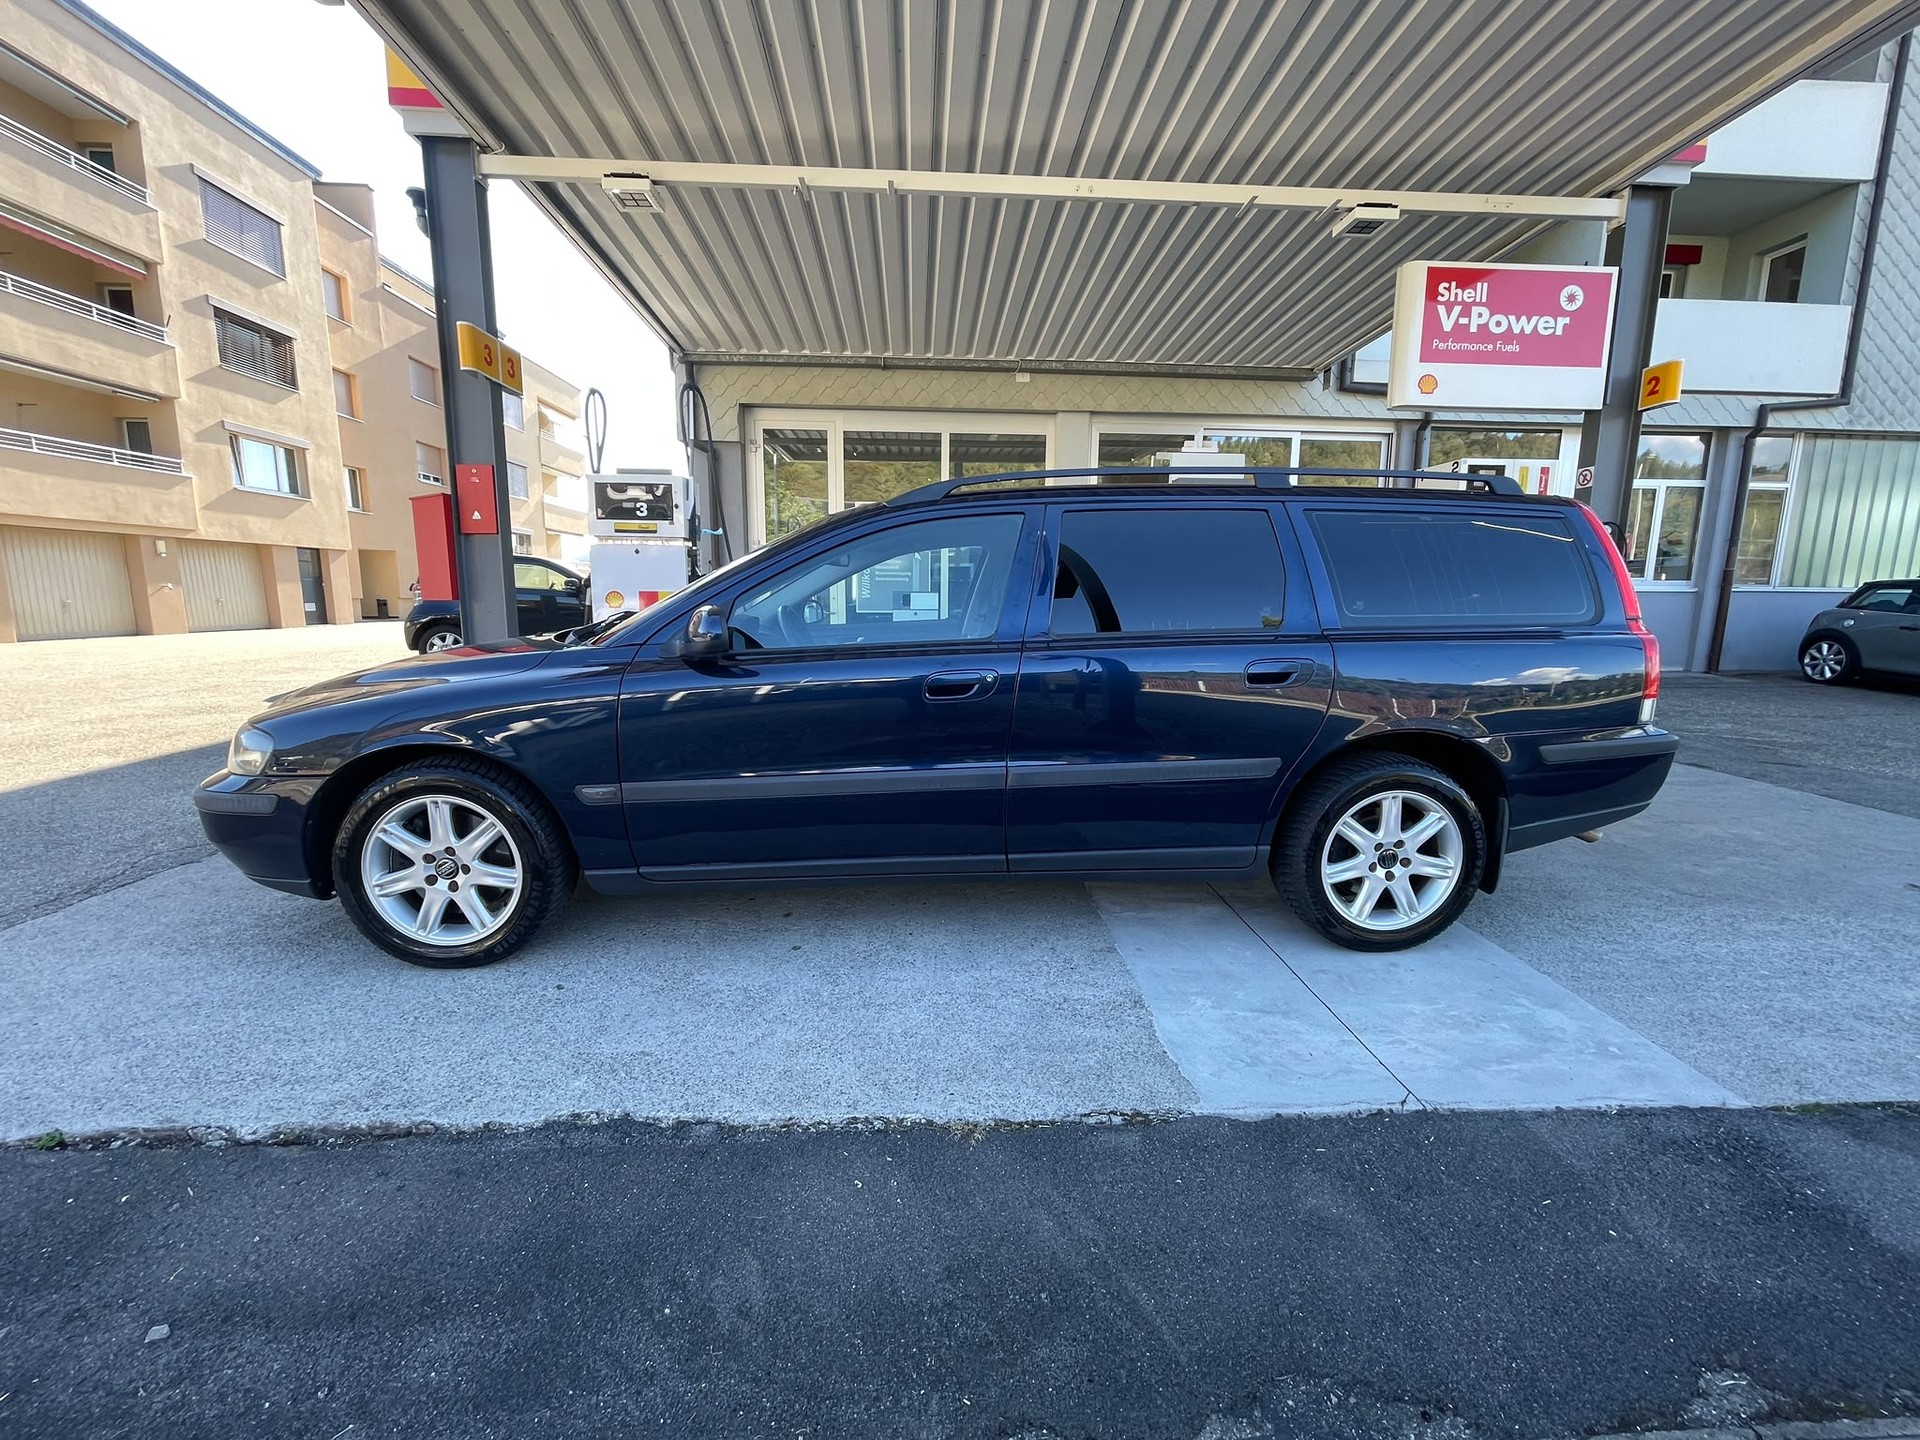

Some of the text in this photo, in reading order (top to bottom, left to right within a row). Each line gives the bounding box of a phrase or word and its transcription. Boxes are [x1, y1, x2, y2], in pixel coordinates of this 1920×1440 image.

[1437, 281, 1488, 303] Shell
[1437, 305, 1570, 336] V-Power
[484, 344, 493, 367] 3
[1432, 338, 1520, 352] Performance Fuels
[507, 356, 516, 379] 3
[1645, 375, 1661, 398] 2
[1451, 461, 1460, 473] 2
[635, 501, 648, 517] 3
